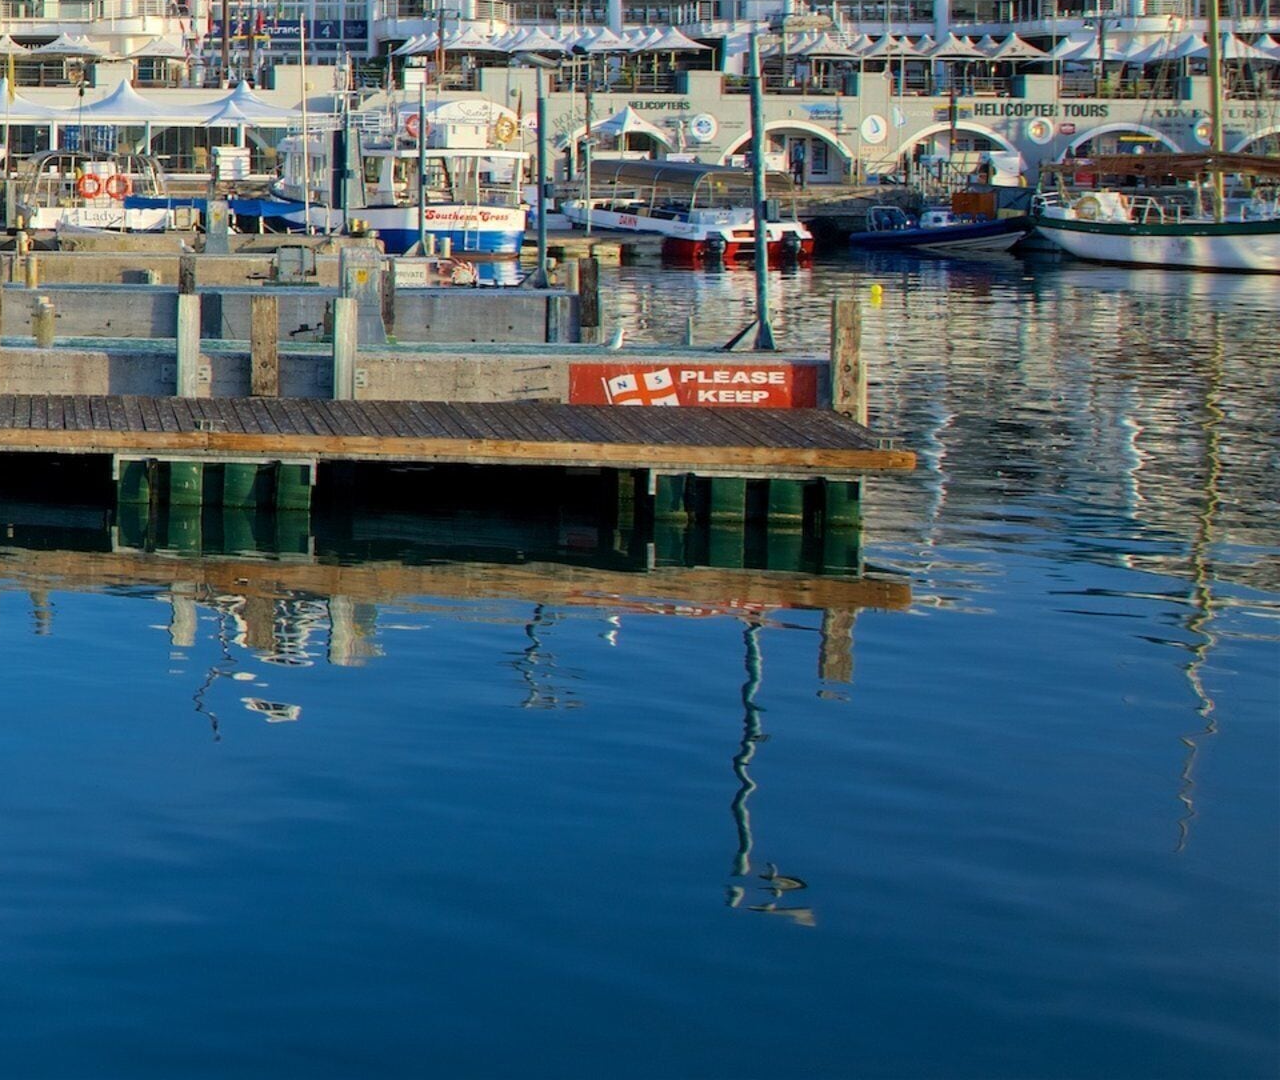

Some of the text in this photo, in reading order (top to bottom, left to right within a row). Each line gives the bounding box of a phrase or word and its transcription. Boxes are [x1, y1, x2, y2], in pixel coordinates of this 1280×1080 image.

[260, 24, 306, 35] Entranc
[628, 101, 690, 110] HELICOPTERS
[1063, 104, 1109, 117] TOURS
[424, 209, 509, 222] Southern Cross
[680, 370, 786, 384] PLEASE
[697, 390, 770, 403] KEEP
